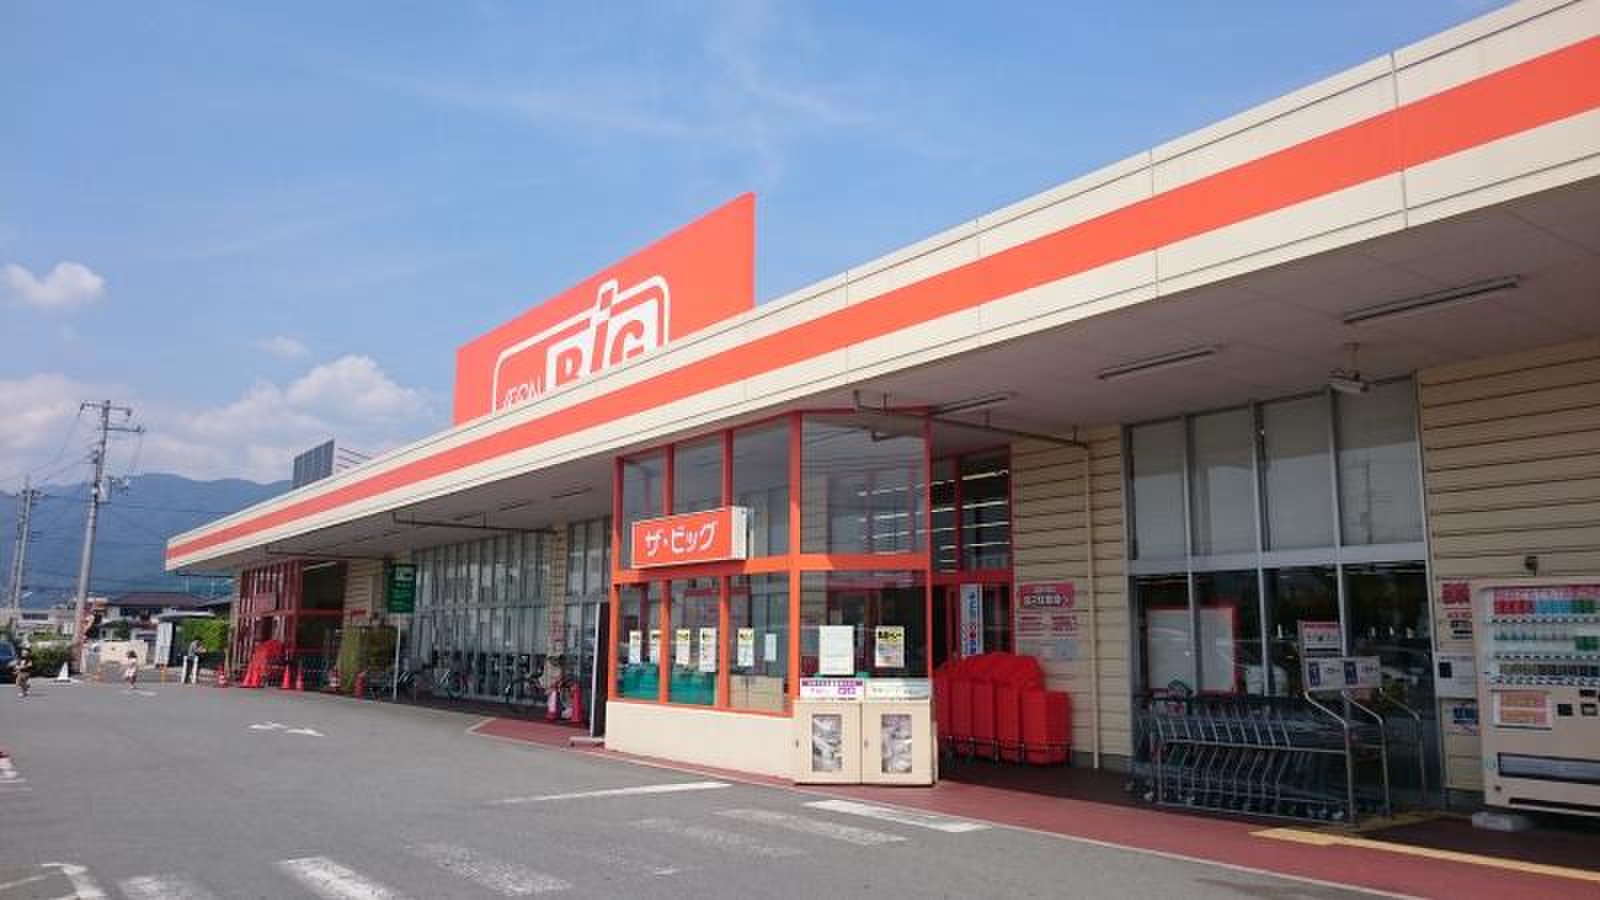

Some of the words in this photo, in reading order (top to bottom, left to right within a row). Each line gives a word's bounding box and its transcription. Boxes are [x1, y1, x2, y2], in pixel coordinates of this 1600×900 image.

[645, 520, 718, 557] ザ・ビッグ
